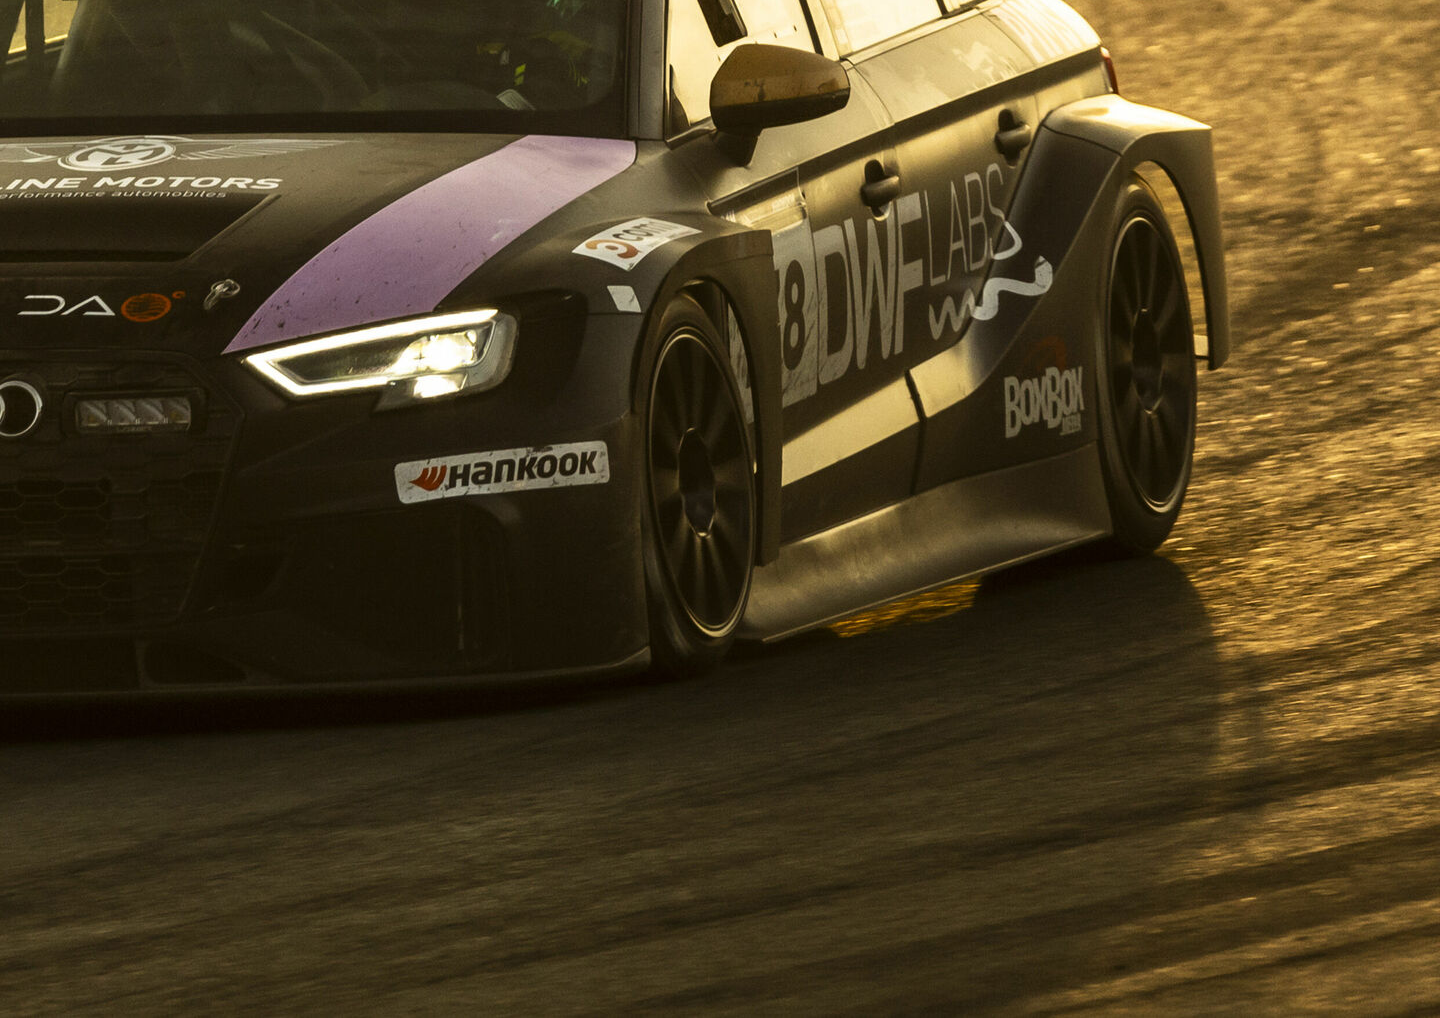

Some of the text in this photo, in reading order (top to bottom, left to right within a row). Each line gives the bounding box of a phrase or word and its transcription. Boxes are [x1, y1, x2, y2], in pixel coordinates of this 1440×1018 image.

[93, 176, 283, 190] MOTORS
[112, 188, 227, 199] automobiles
[812, 162, 1023, 385] DWF LABS
[783, 259, 806, 371] 8
